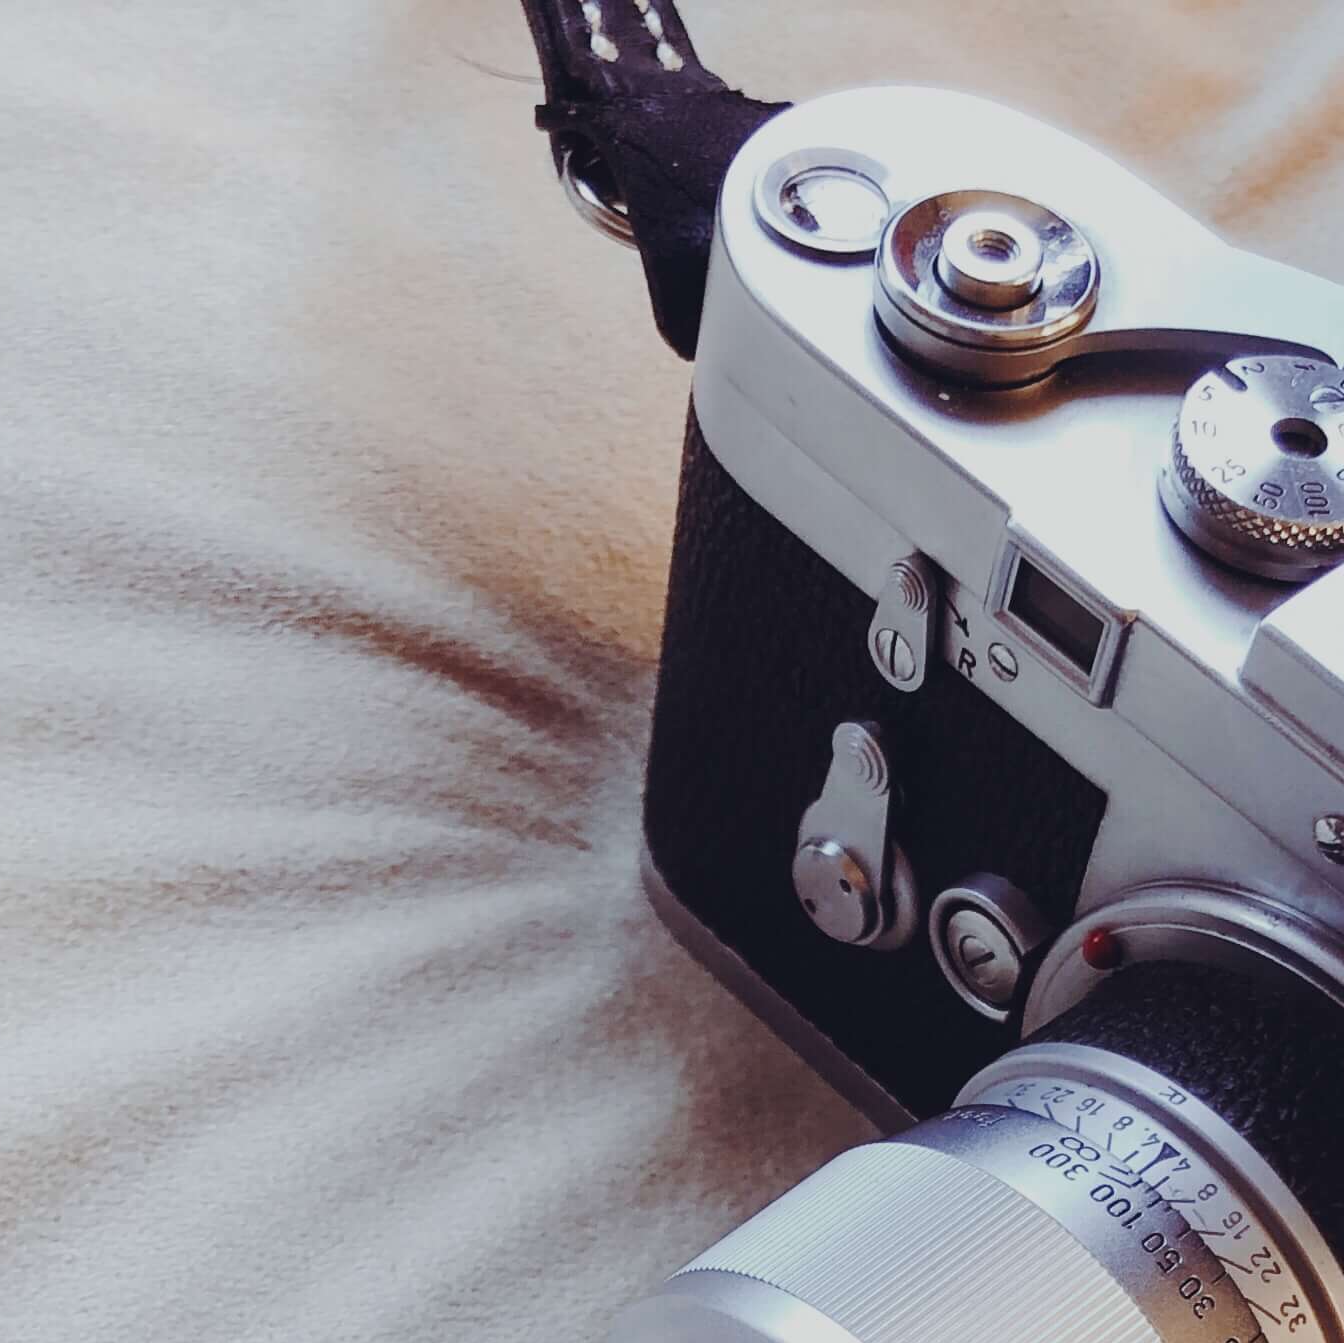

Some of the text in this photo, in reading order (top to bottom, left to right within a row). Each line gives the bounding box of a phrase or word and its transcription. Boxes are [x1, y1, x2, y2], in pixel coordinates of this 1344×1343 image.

[1241, 362, 1264, 375] 2
[1198, 385, 1216, 401] 5
[1191, 419, 1217, 438] 10
[1211, 458, 1246, 484] 25
[1254, 481, 1284, 510] 50
[1300, 482, 1330, 517] 100
[958, 647, 977, 678] R
[1040, 1087, 1075, 1103] 22
[1076, 1098, 1105, 1116] 16
[1159, 1085, 1187, 1105] R
[1113, 1116, 1134, 1130] 8
[1029, 1143, 1089, 1182] 300
[1089, 1183, 1142, 1230] 100
[1198, 1183, 1218, 1202] 8
[1222, 1211, 1250, 1240] 16
[1141, 1232, 1184, 1275] 50
[1250, 1247, 1281, 1283] 22
[1178, 1276, 1216, 1320] 30
[1280, 1295, 1307, 1334] 32
